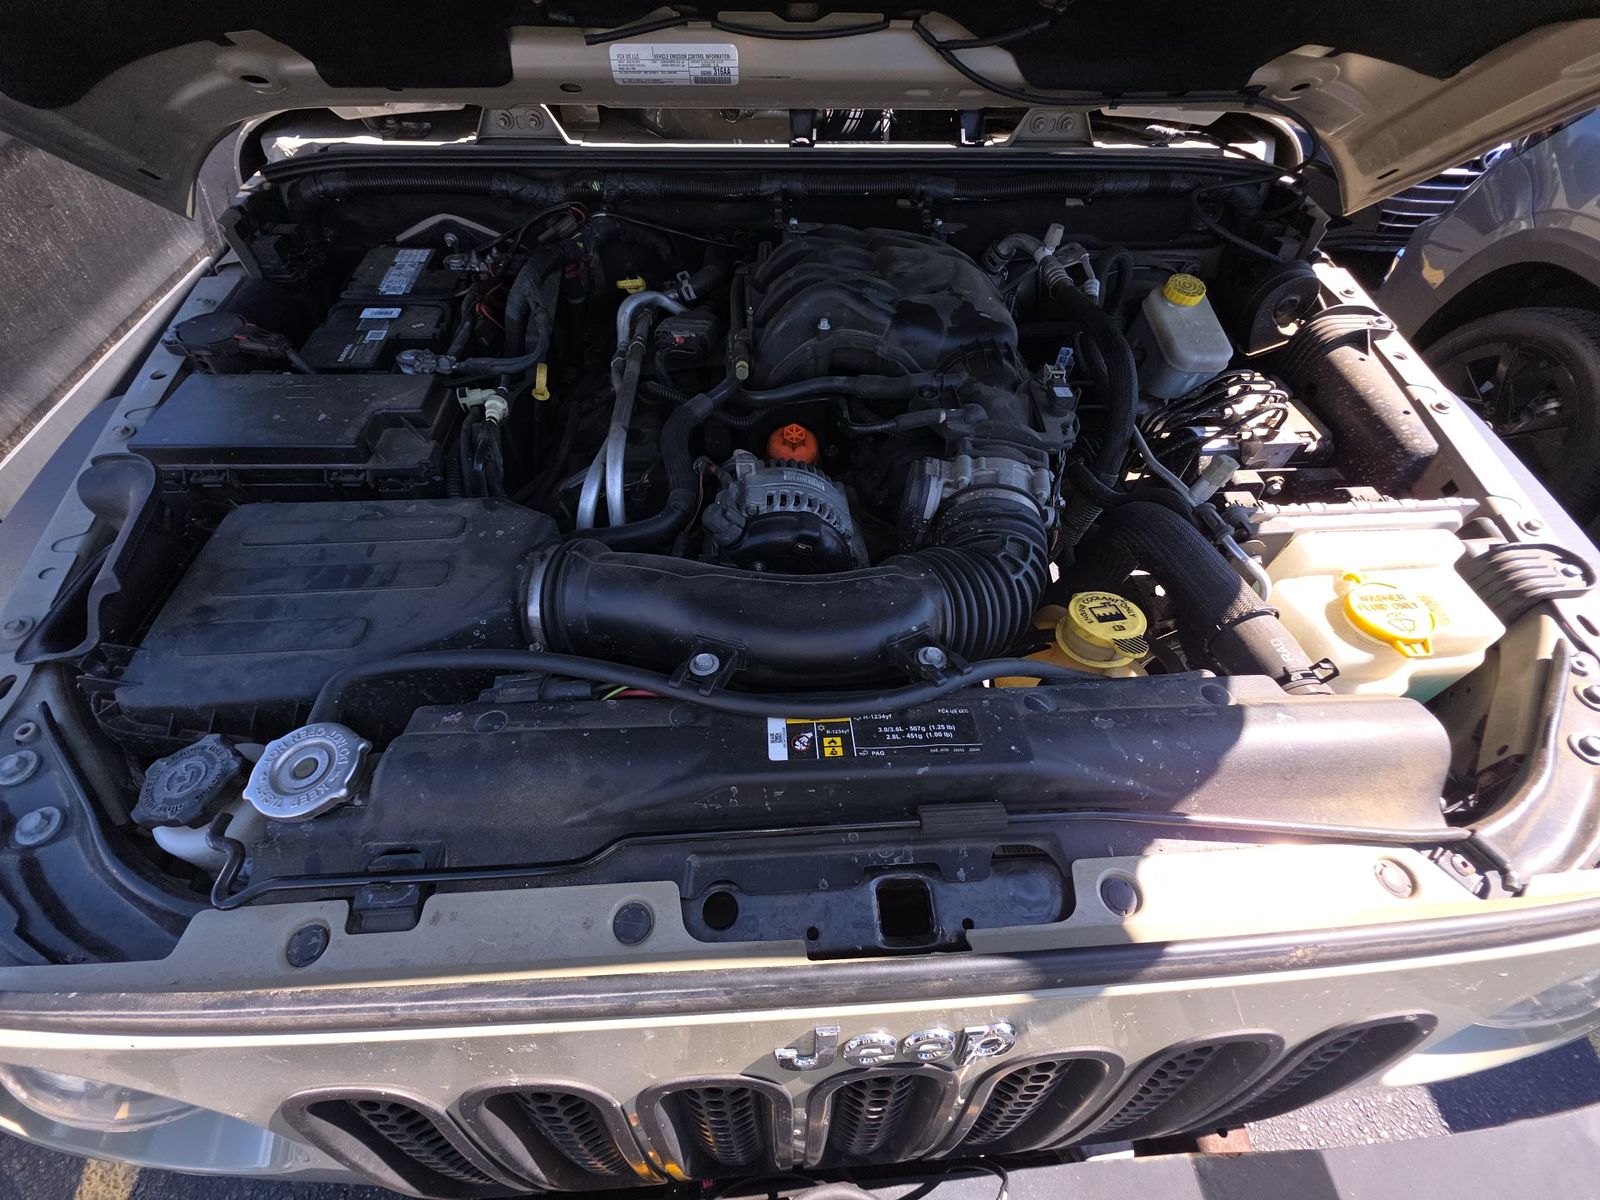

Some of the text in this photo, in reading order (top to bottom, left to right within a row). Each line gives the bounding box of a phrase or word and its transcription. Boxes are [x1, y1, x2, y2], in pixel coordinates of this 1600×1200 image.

[1082, 596, 1118, 604] COOLANT
[1120, 600, 1136, 618] ONLY
[290, 727, 326, 744] OPEN
[264, 742, 289, 763] HOT
[290, 783, 330, 808] KEEP
[774, 1023, 1018, 1072] Jeep
